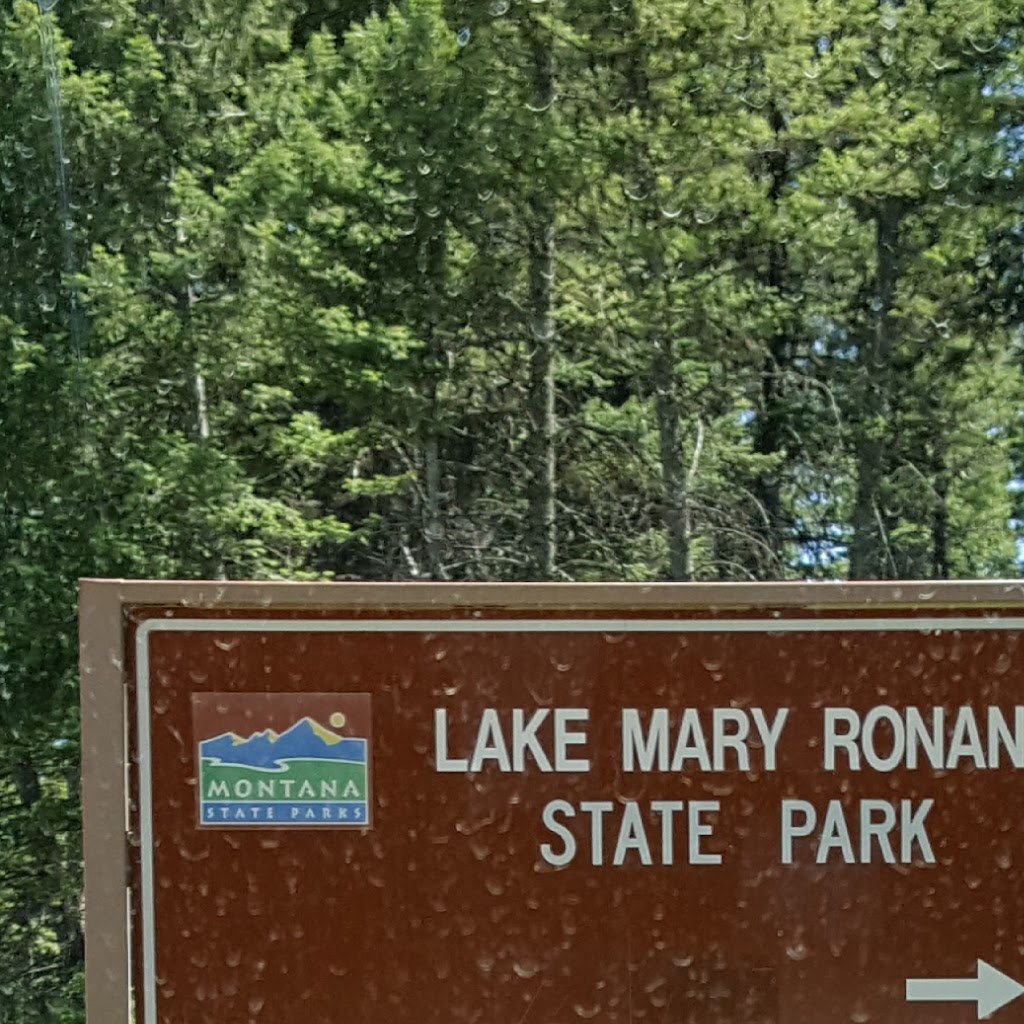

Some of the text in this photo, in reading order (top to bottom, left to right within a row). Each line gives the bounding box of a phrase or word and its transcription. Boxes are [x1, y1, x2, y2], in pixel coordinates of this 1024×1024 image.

[434, 708, 590, 772] LAKE
[621, 708, 789, 772] MARY
[207, 779, 360, 798] MONTANA
[207, 807, 362, 819] STATE PARKS
[540, 799, 936, 866] STATE PARK
